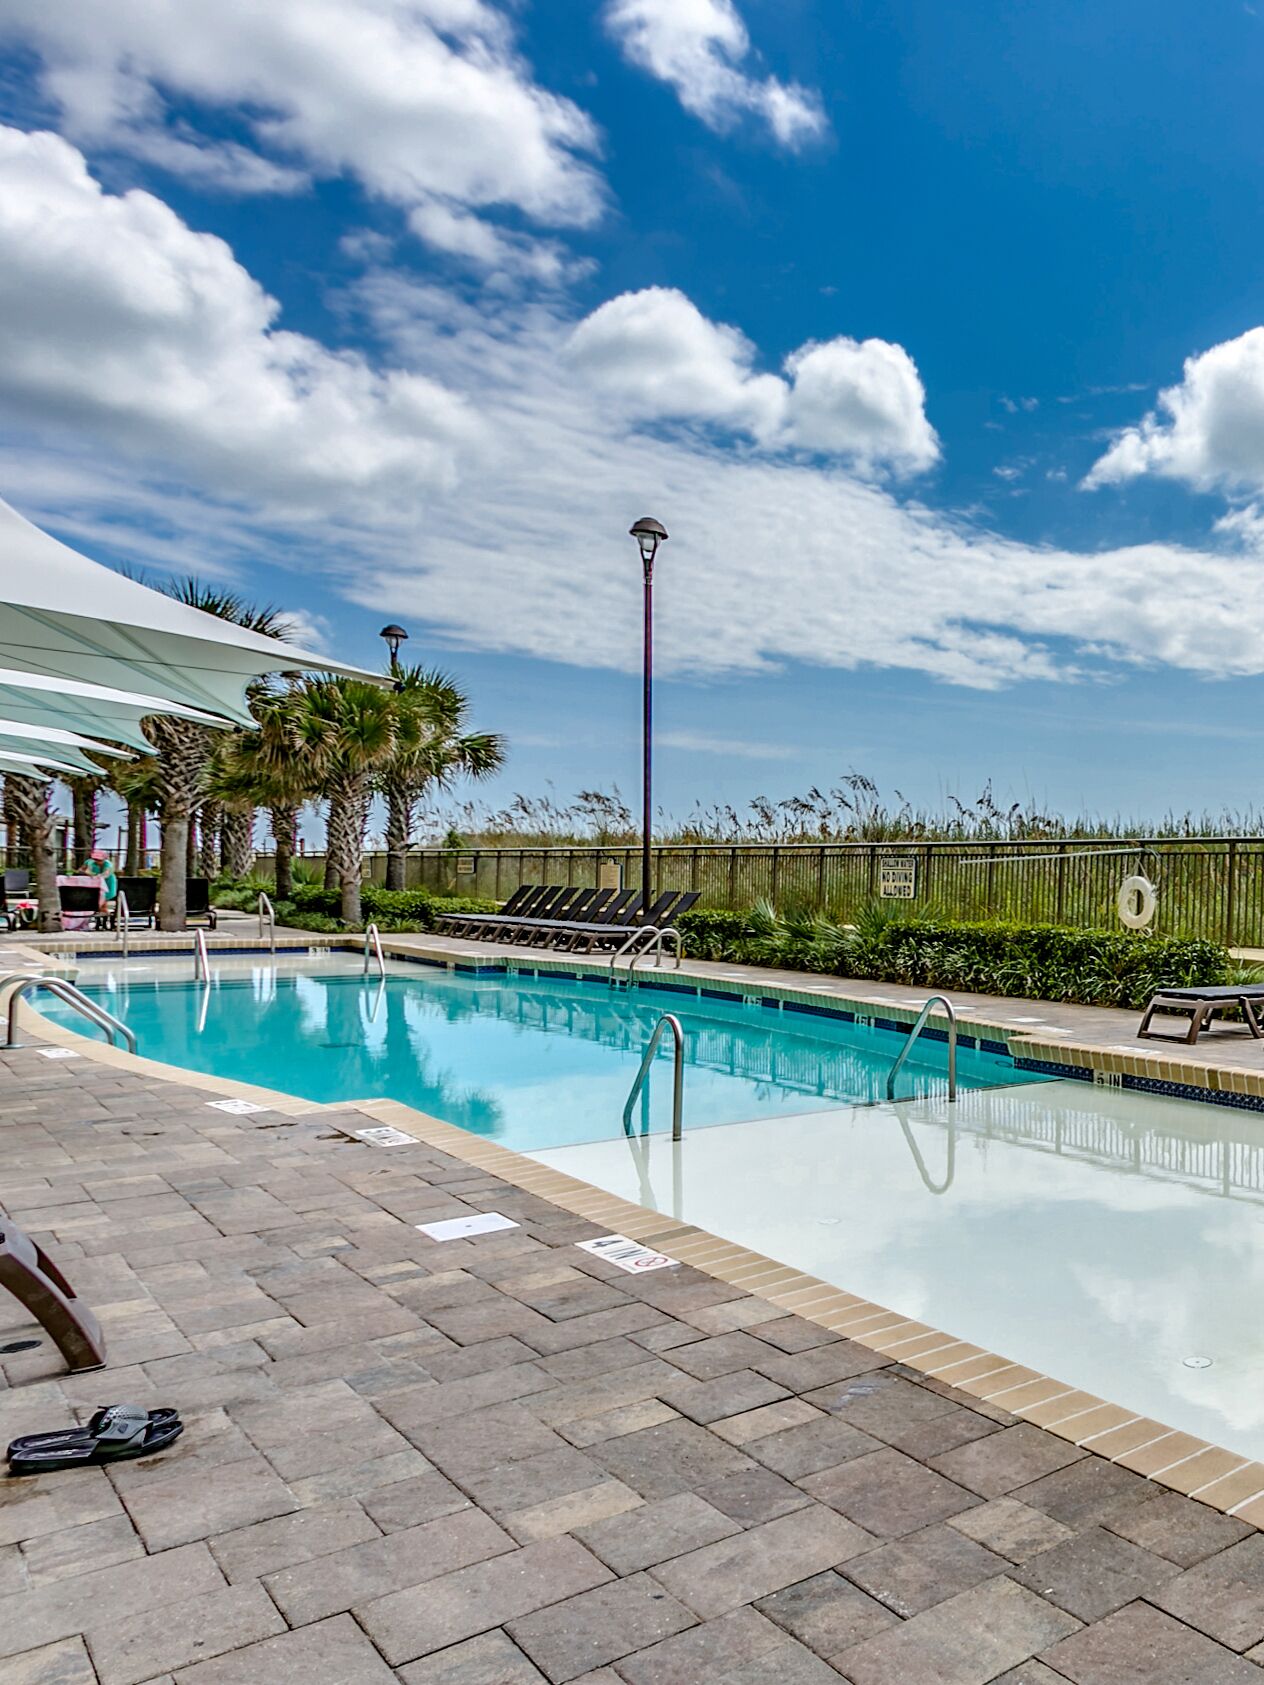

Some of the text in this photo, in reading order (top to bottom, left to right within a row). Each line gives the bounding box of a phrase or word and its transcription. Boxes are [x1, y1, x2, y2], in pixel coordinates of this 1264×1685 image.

[882, 871, 913, 883] NO DIVING
[883, 885, 911, 897] ALLOWED
[1097, 1072, 1120, 1087] 5 IN
[591, 1239, 649, 1261] 4 IN
